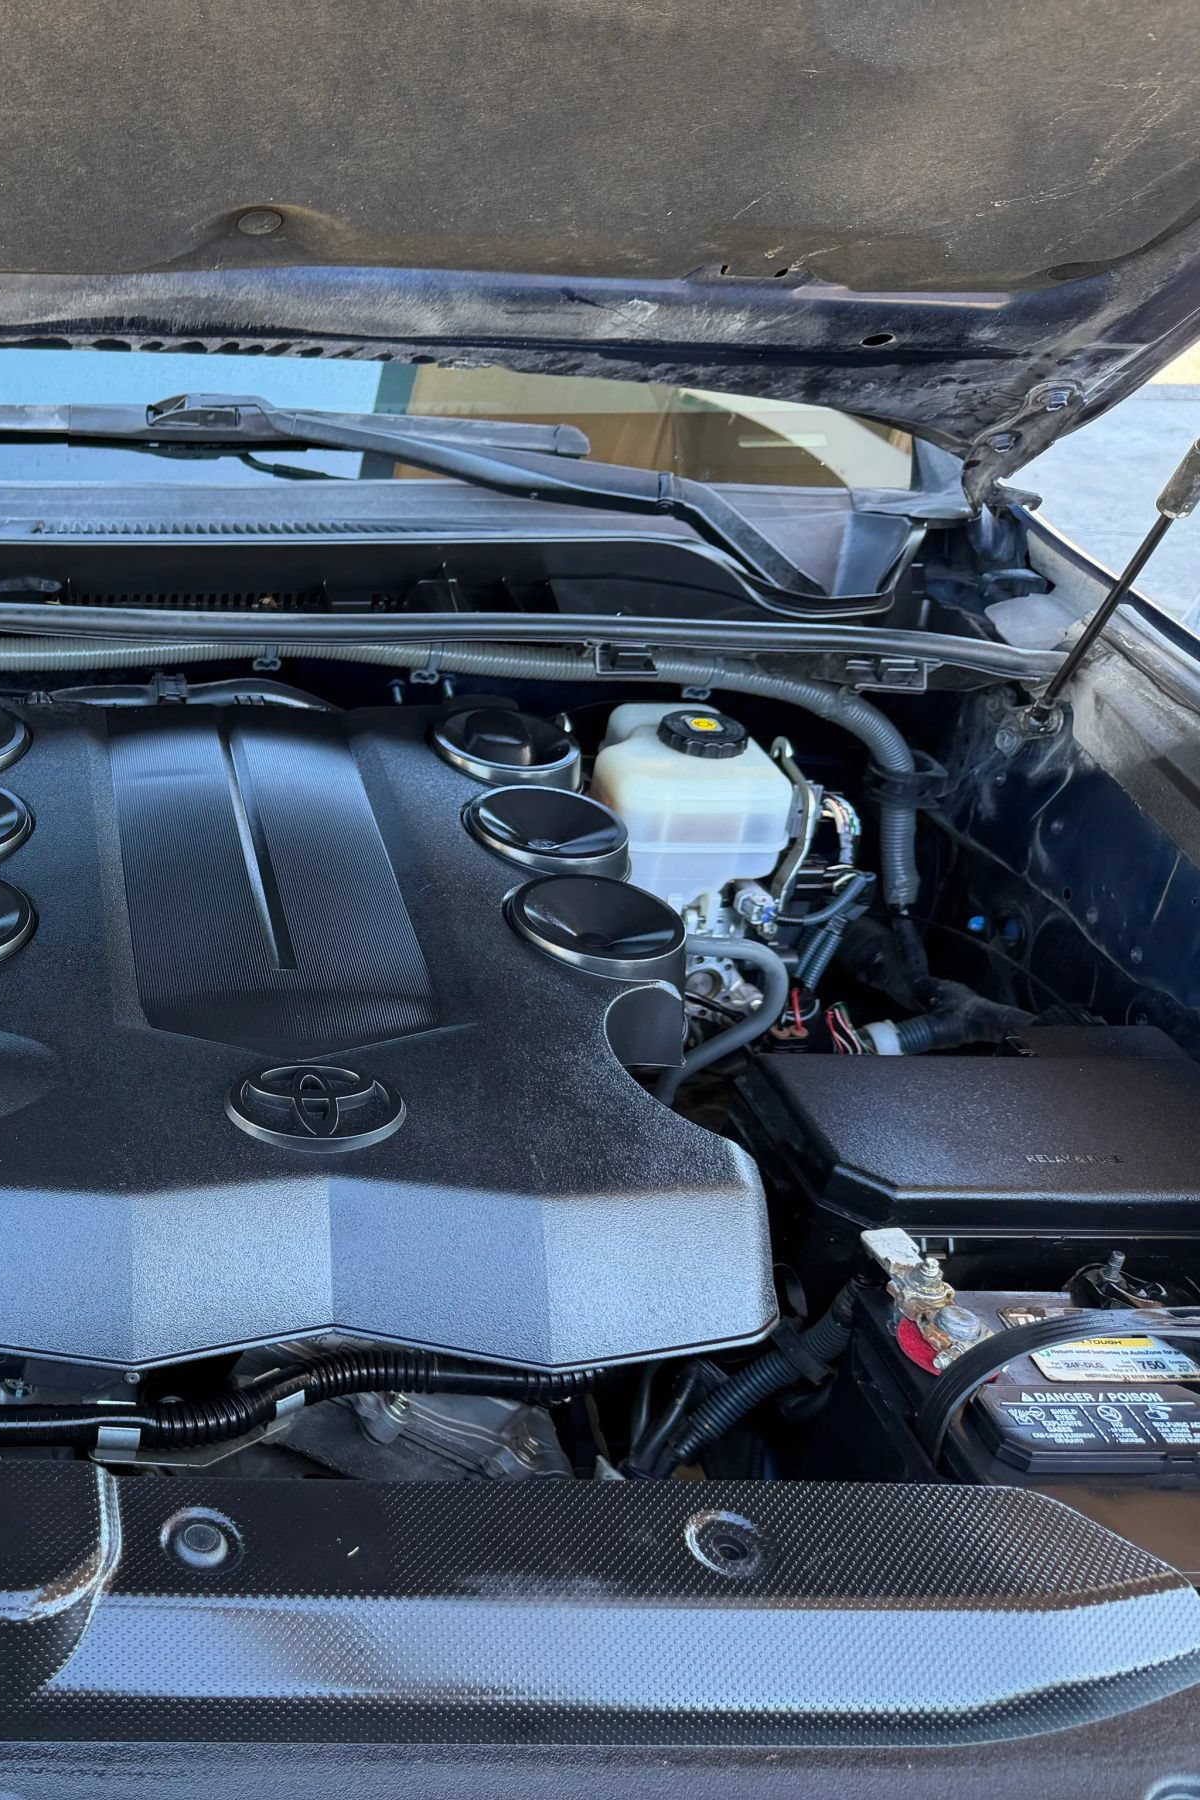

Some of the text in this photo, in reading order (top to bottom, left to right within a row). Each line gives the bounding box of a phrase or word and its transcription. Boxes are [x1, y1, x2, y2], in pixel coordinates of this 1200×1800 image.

[1025, 1154, 1070, 1163] RELAY
[1136, 1360, 1166, 1370] 750
[1033, 1392, 1096, 1402] DANGER
[1106, 1392, 1164, 1402] POISON
